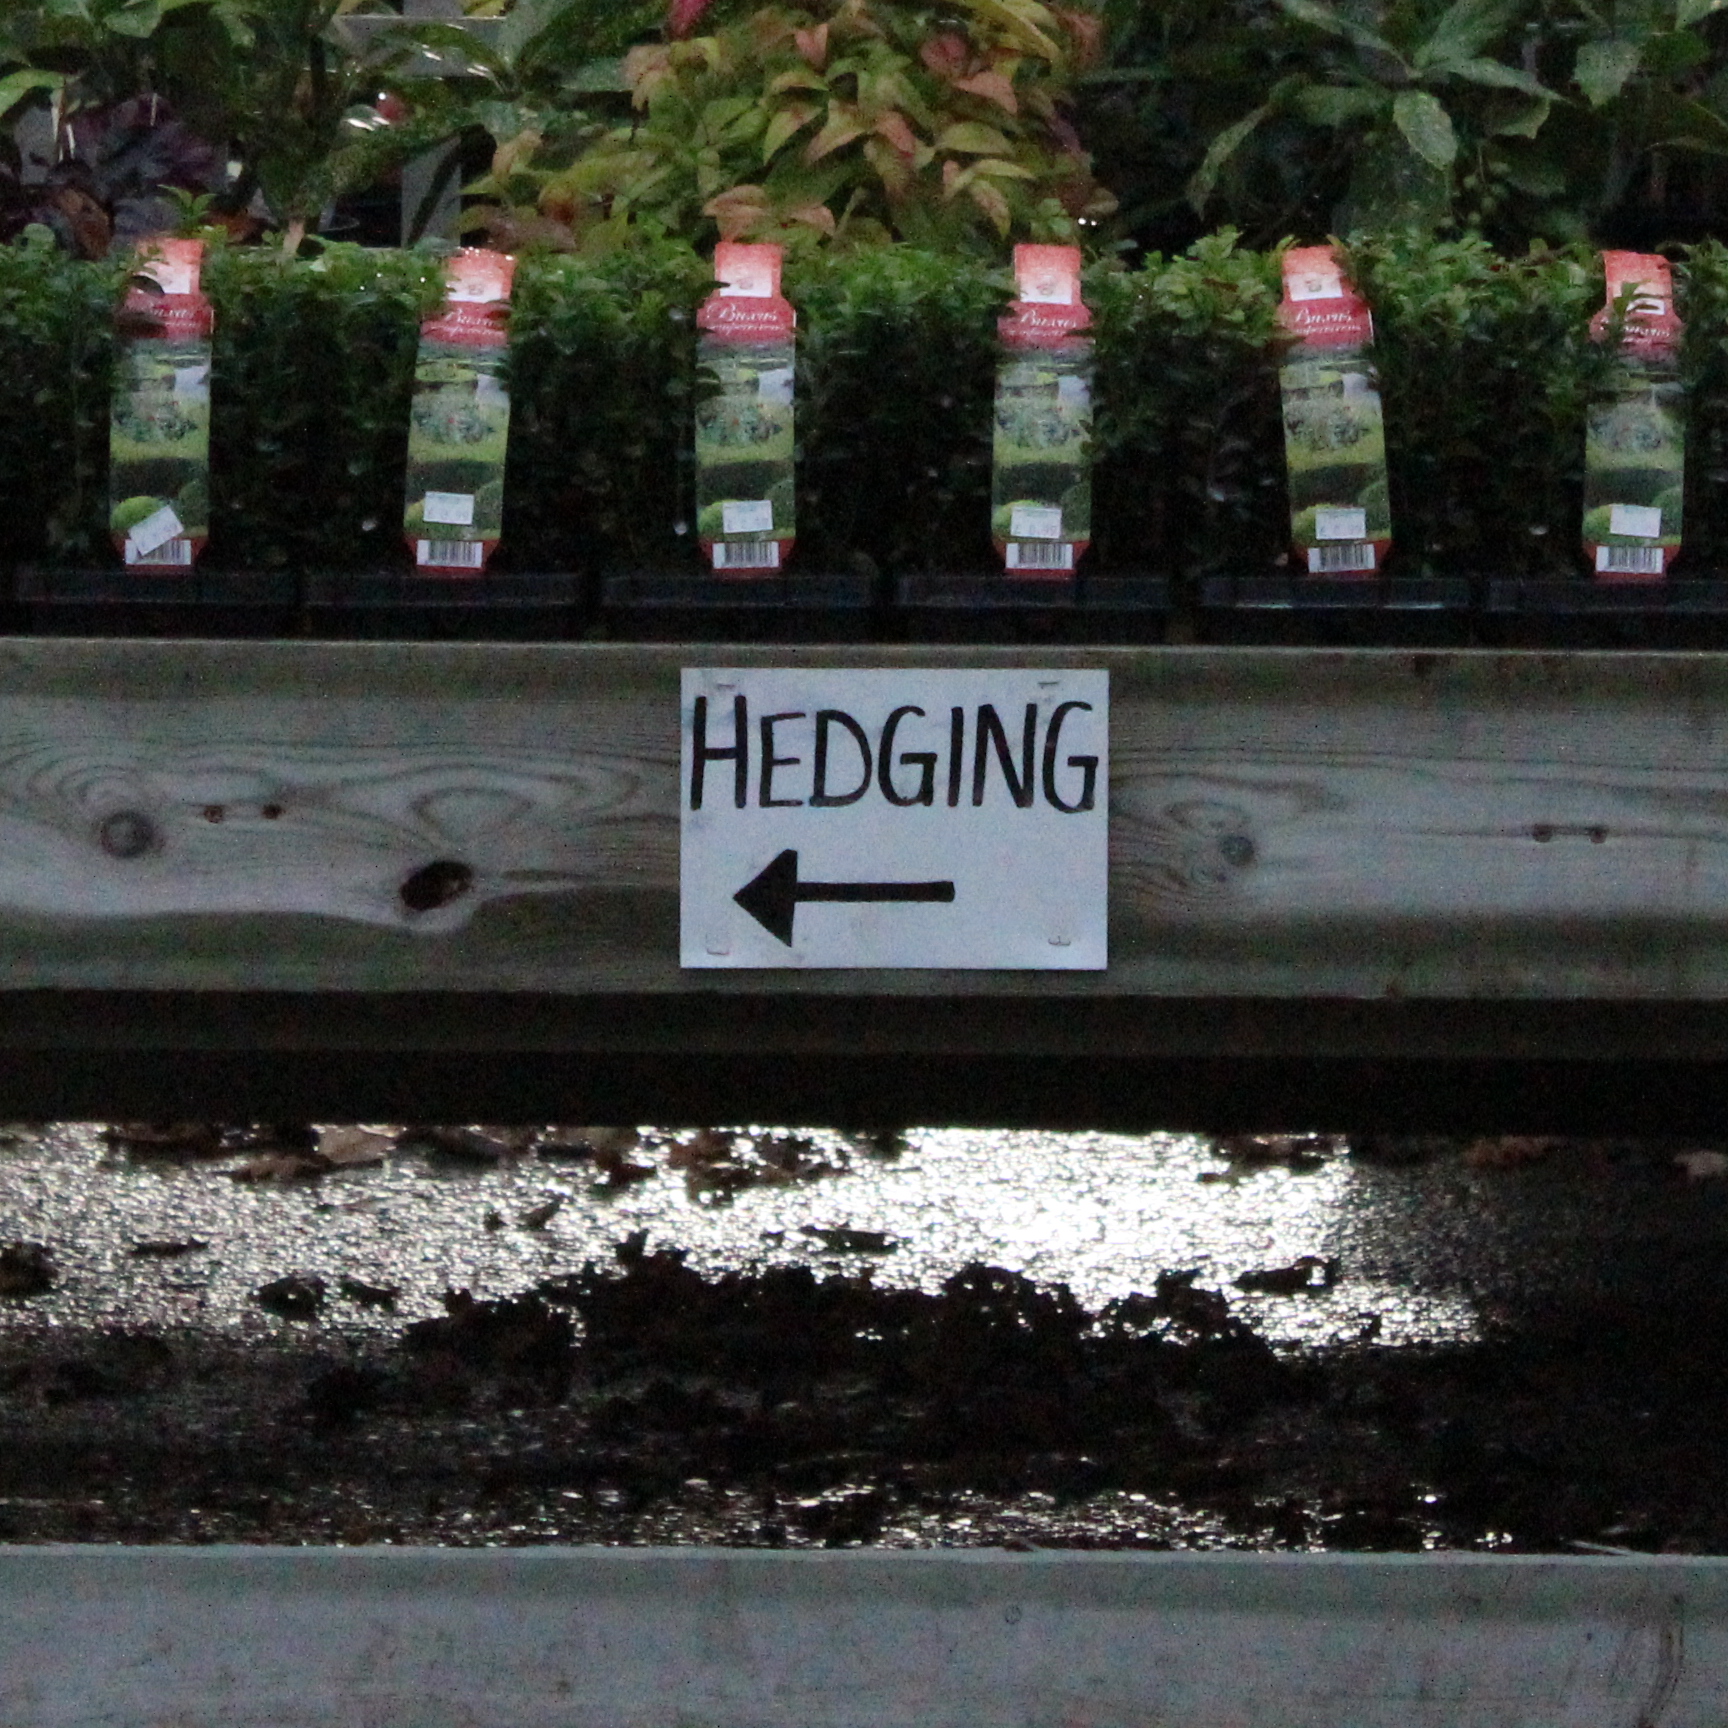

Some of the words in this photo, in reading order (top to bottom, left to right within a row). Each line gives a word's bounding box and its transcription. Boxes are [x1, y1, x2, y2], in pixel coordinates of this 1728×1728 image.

[706, 302, 778, 322] Buxus
[1295, 308, 1353, 325] Buxus
[690, 694, 1099, 814] HEDGING
